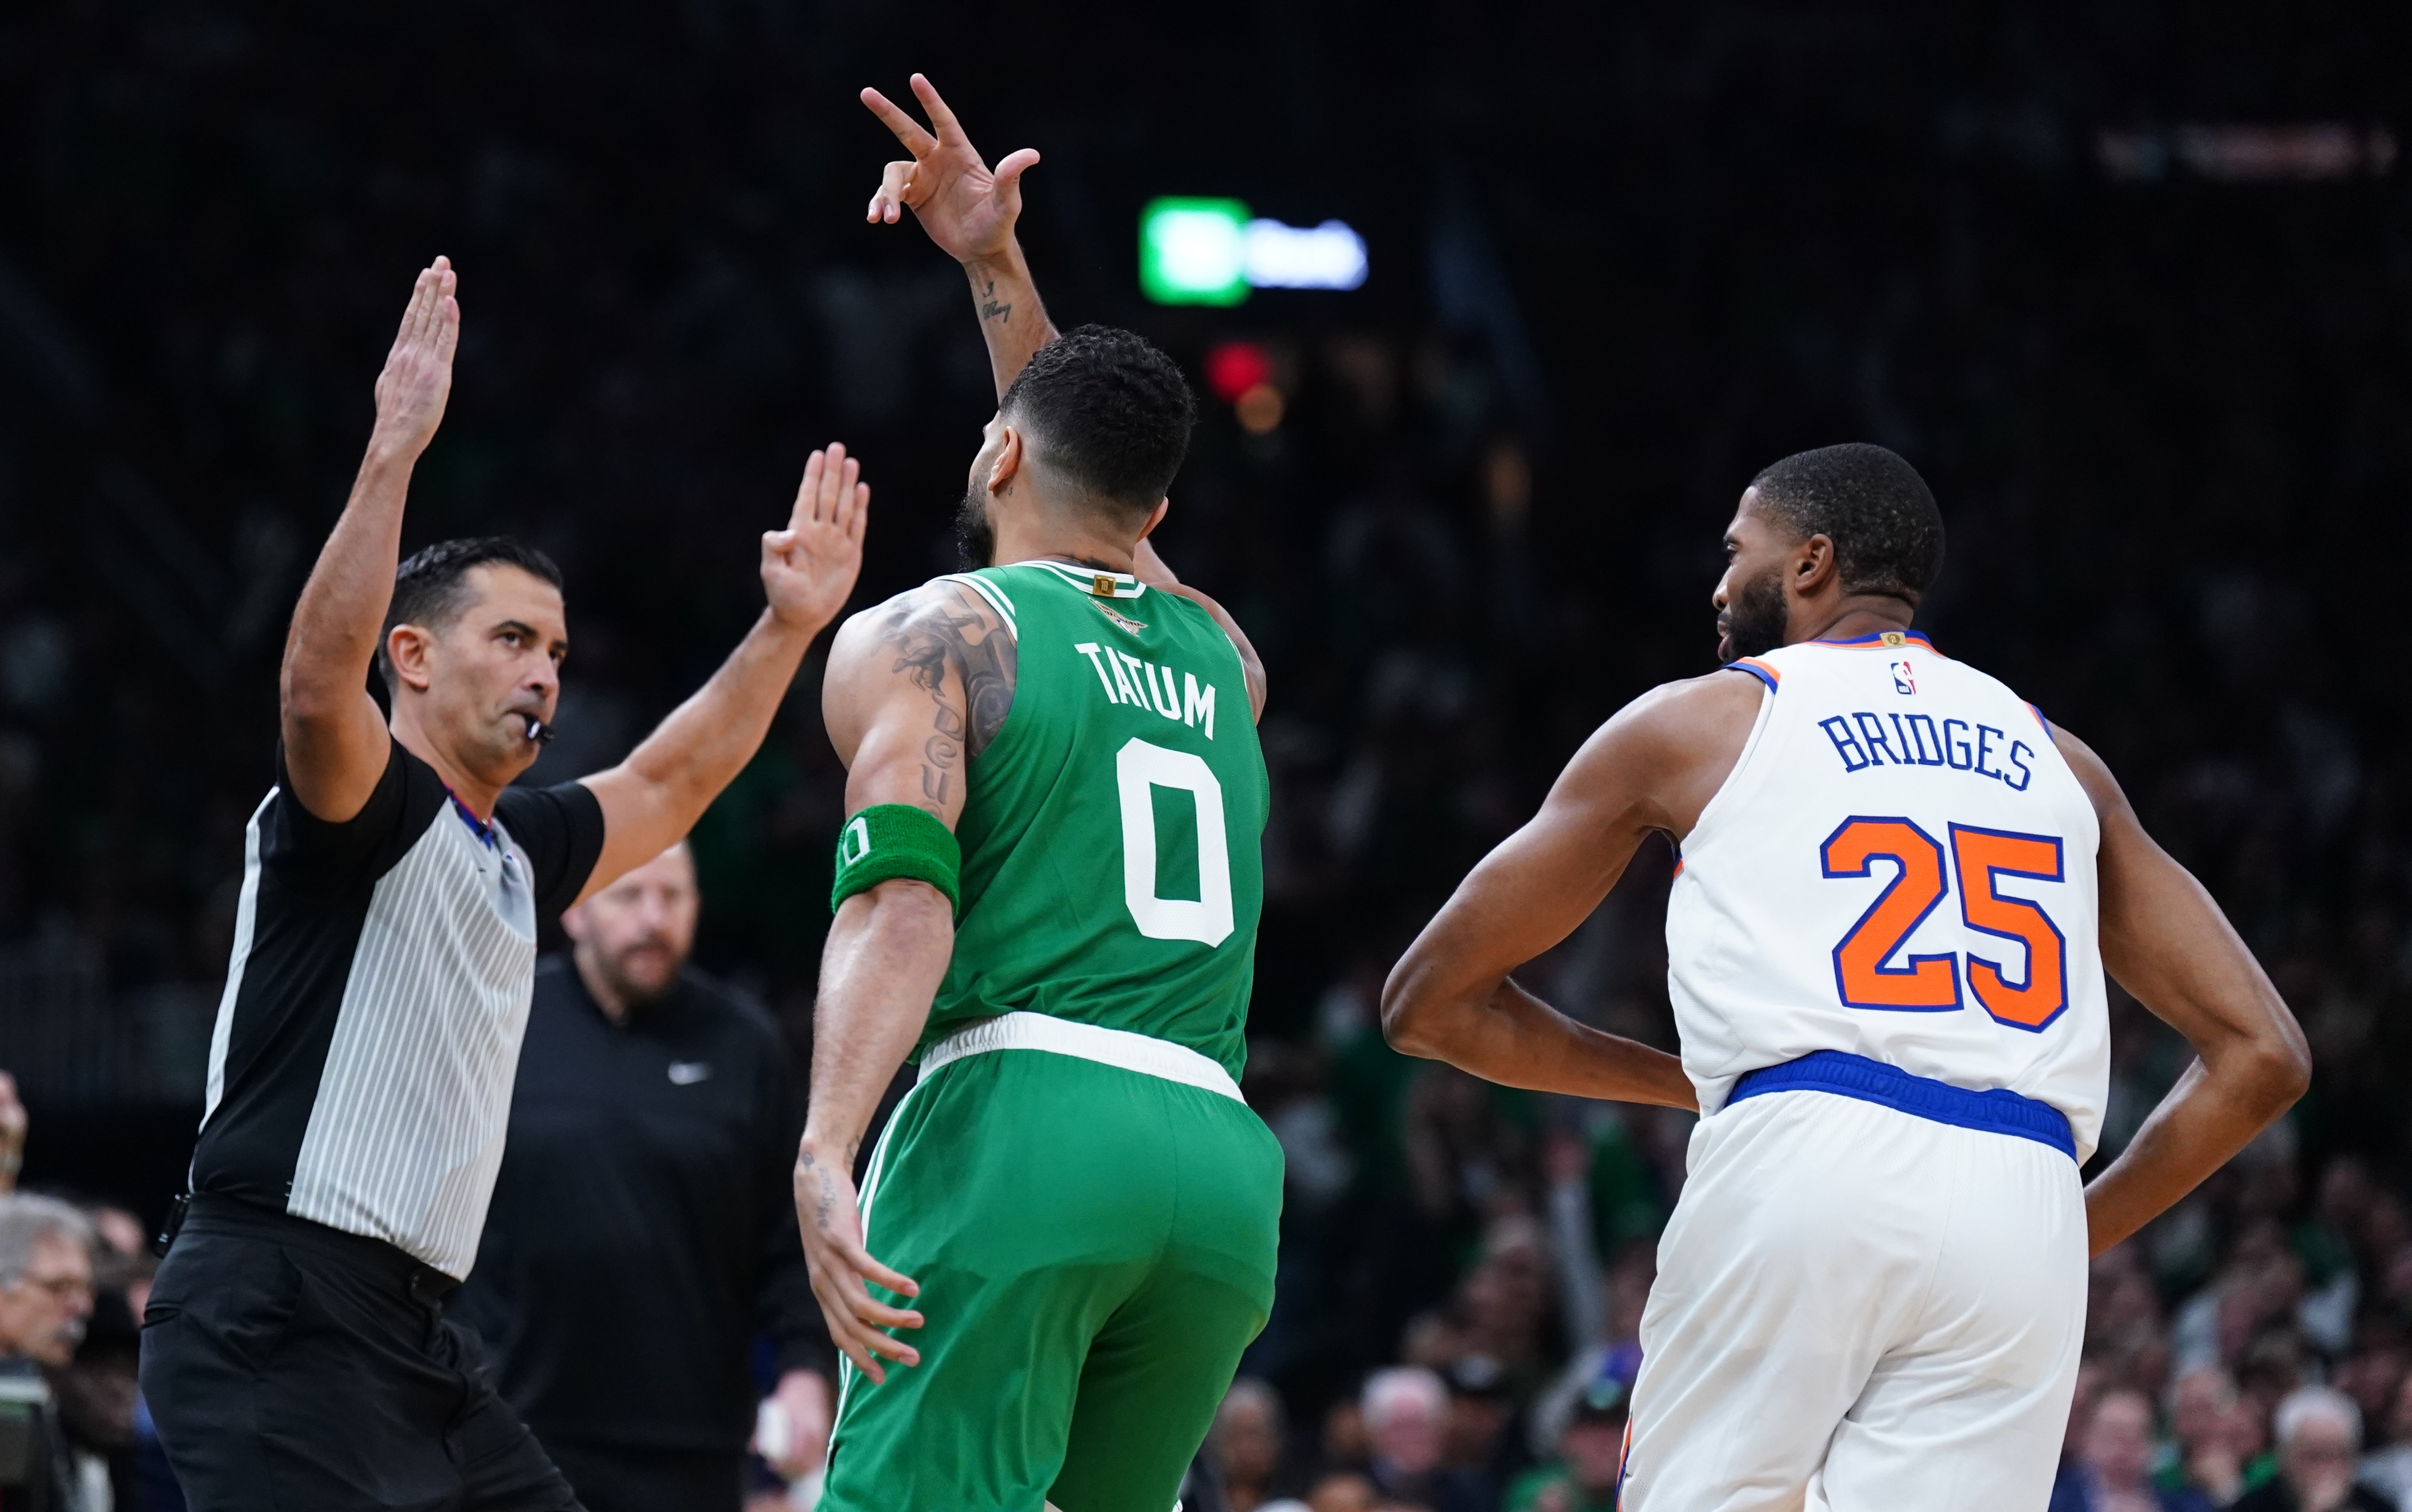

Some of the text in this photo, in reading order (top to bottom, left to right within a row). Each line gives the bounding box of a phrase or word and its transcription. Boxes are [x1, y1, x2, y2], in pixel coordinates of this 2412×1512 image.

[1074, 642, 1216, 741] TATUM
[1898, 685, 1910, 693] NBA
[1817, 712, 2035, 792] BRIDGES
[842, 816, 871, 867] 0
[1116, 737, 1235, 949] 0
[1819, 815, 2069, 1034] 25
